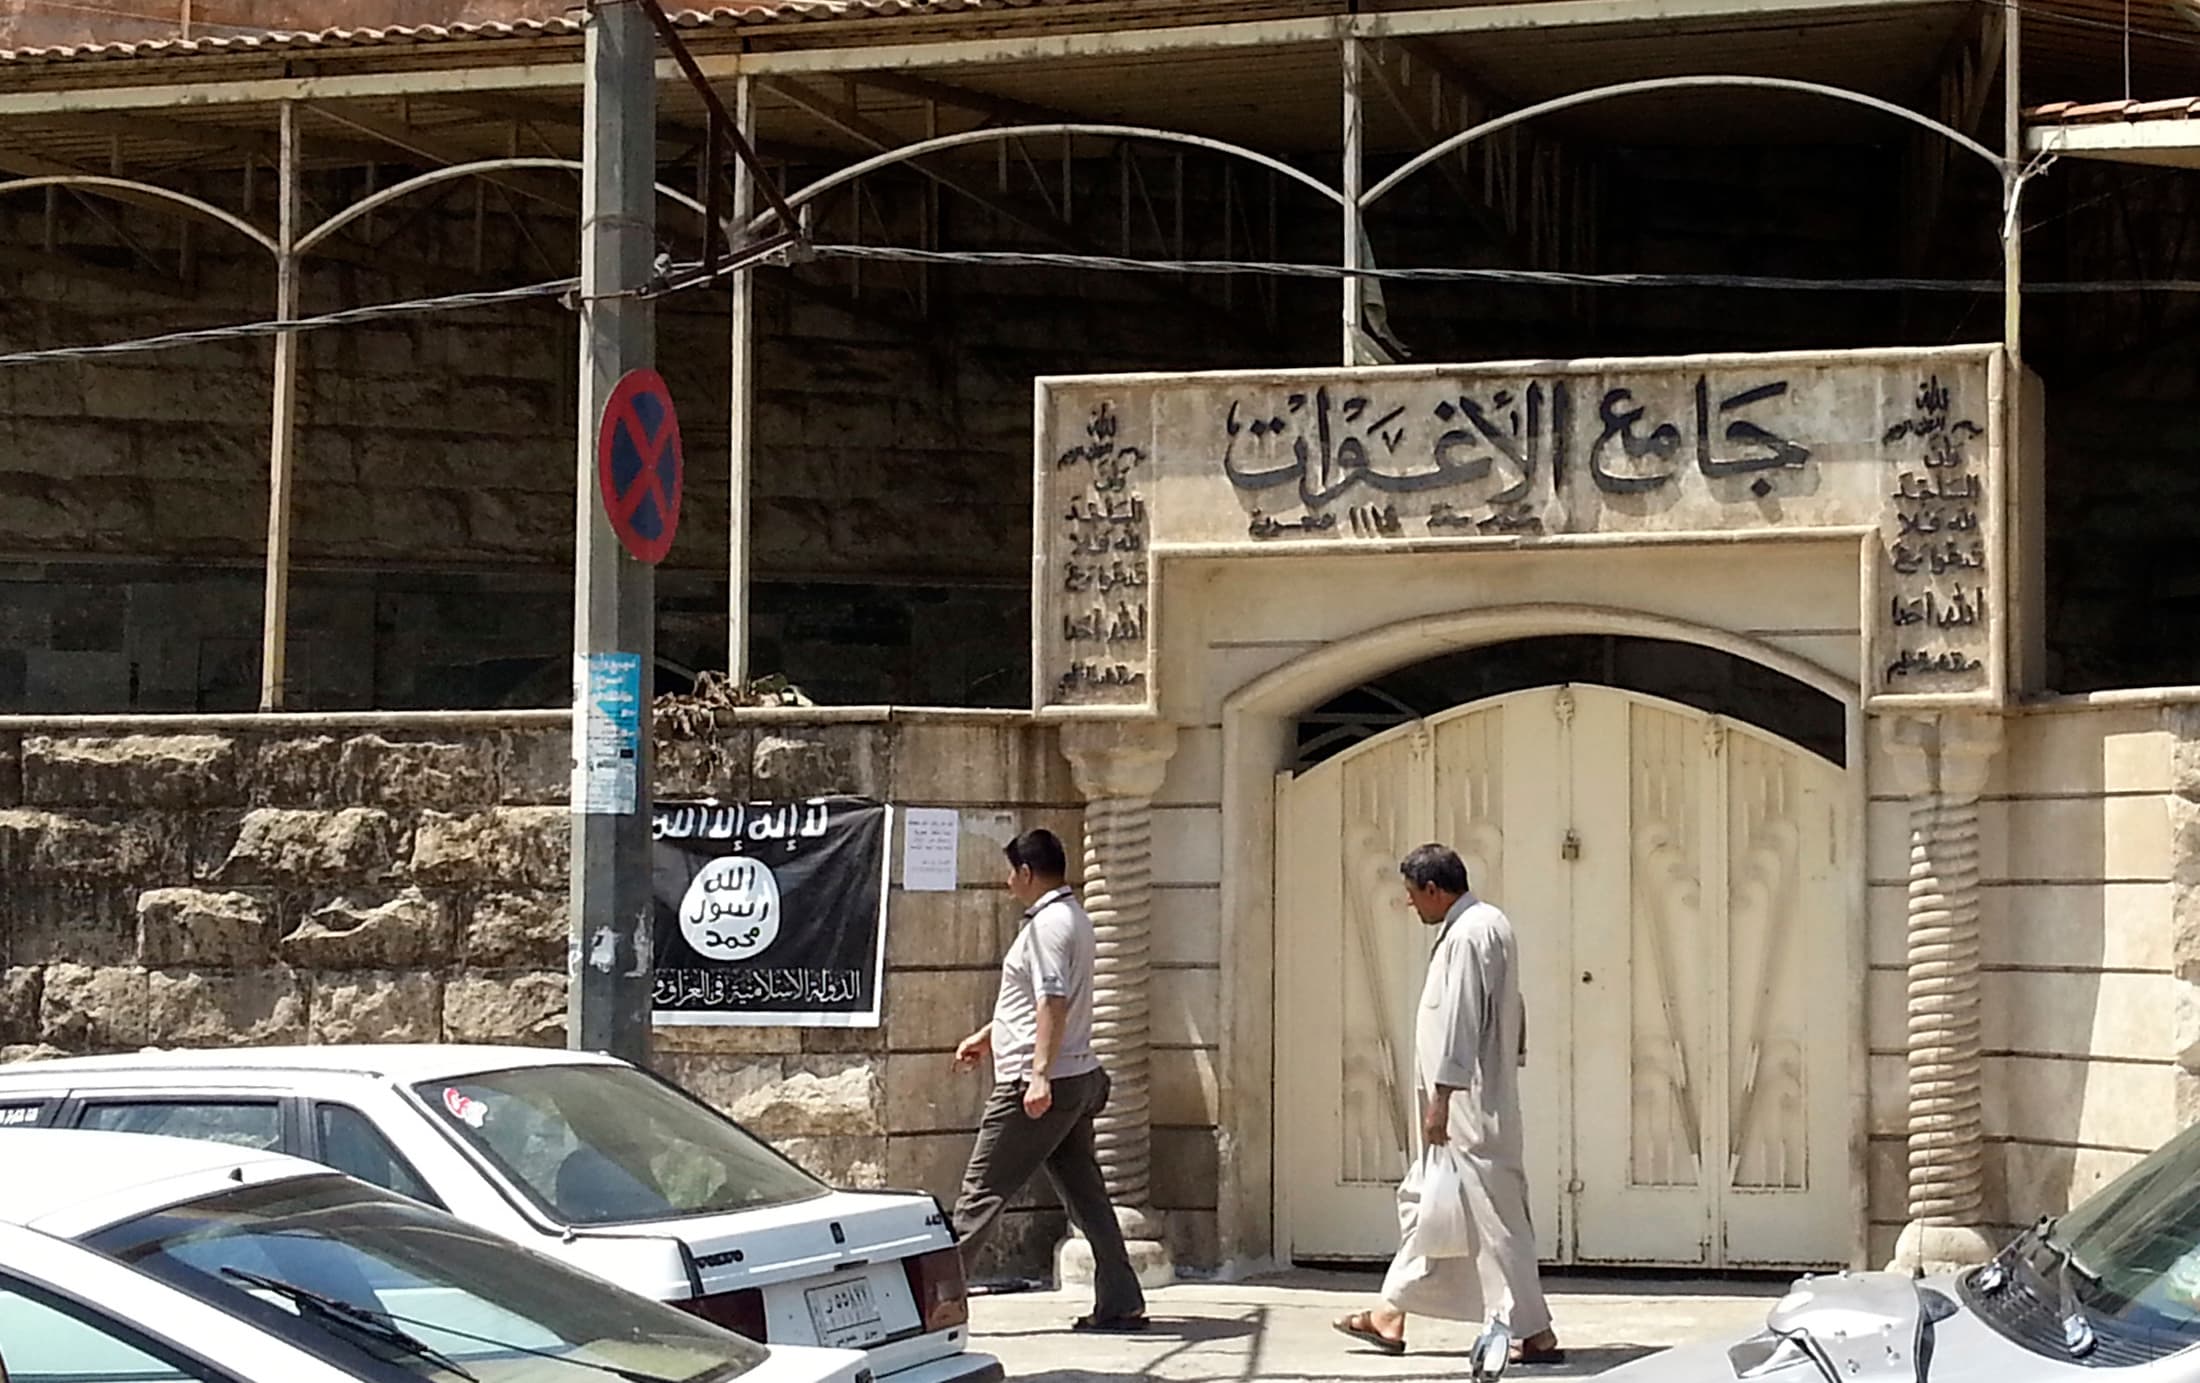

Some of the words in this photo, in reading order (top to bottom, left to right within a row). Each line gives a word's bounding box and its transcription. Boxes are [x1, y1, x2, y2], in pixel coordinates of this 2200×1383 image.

[801, 805, 829, 838] لا
[704, 865, 757, 893] الله
[690, 899, 770, 925] رسول
[706, 926, 761, 949] محمد
[807, 967, 861, 1003] الدولة
